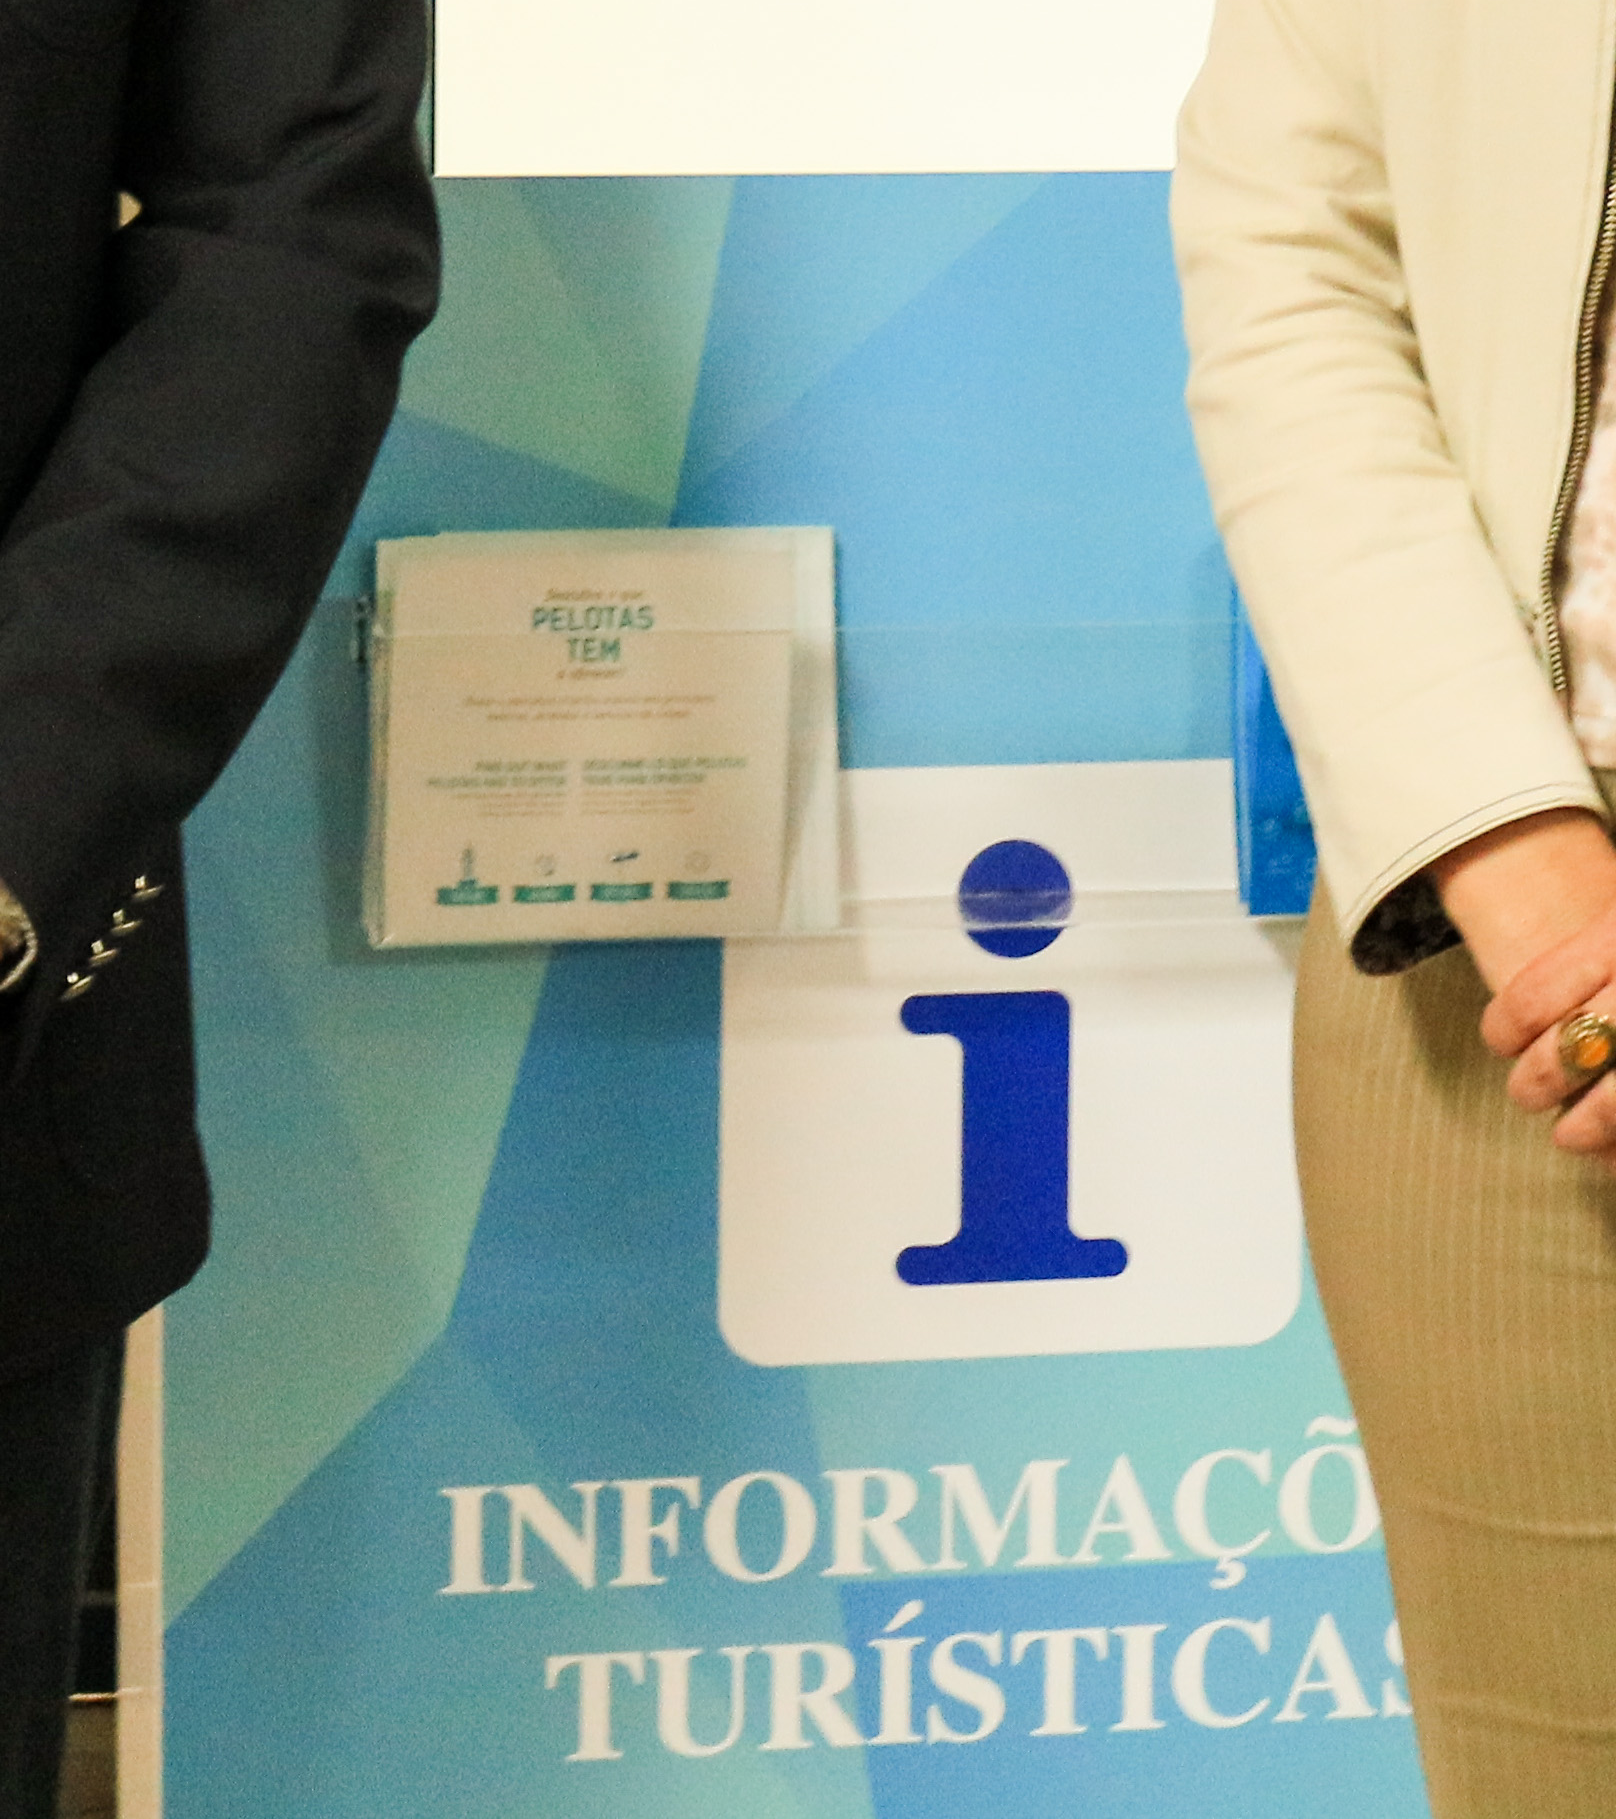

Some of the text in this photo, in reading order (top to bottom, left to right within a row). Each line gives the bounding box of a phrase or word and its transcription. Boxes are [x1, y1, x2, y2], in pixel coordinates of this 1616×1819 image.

[532, 605, 655, 632] PELOTAS
[566, 636, 622, 663] TEM
[439, 1413, 1383, 1598] INFORMAÇÕ
